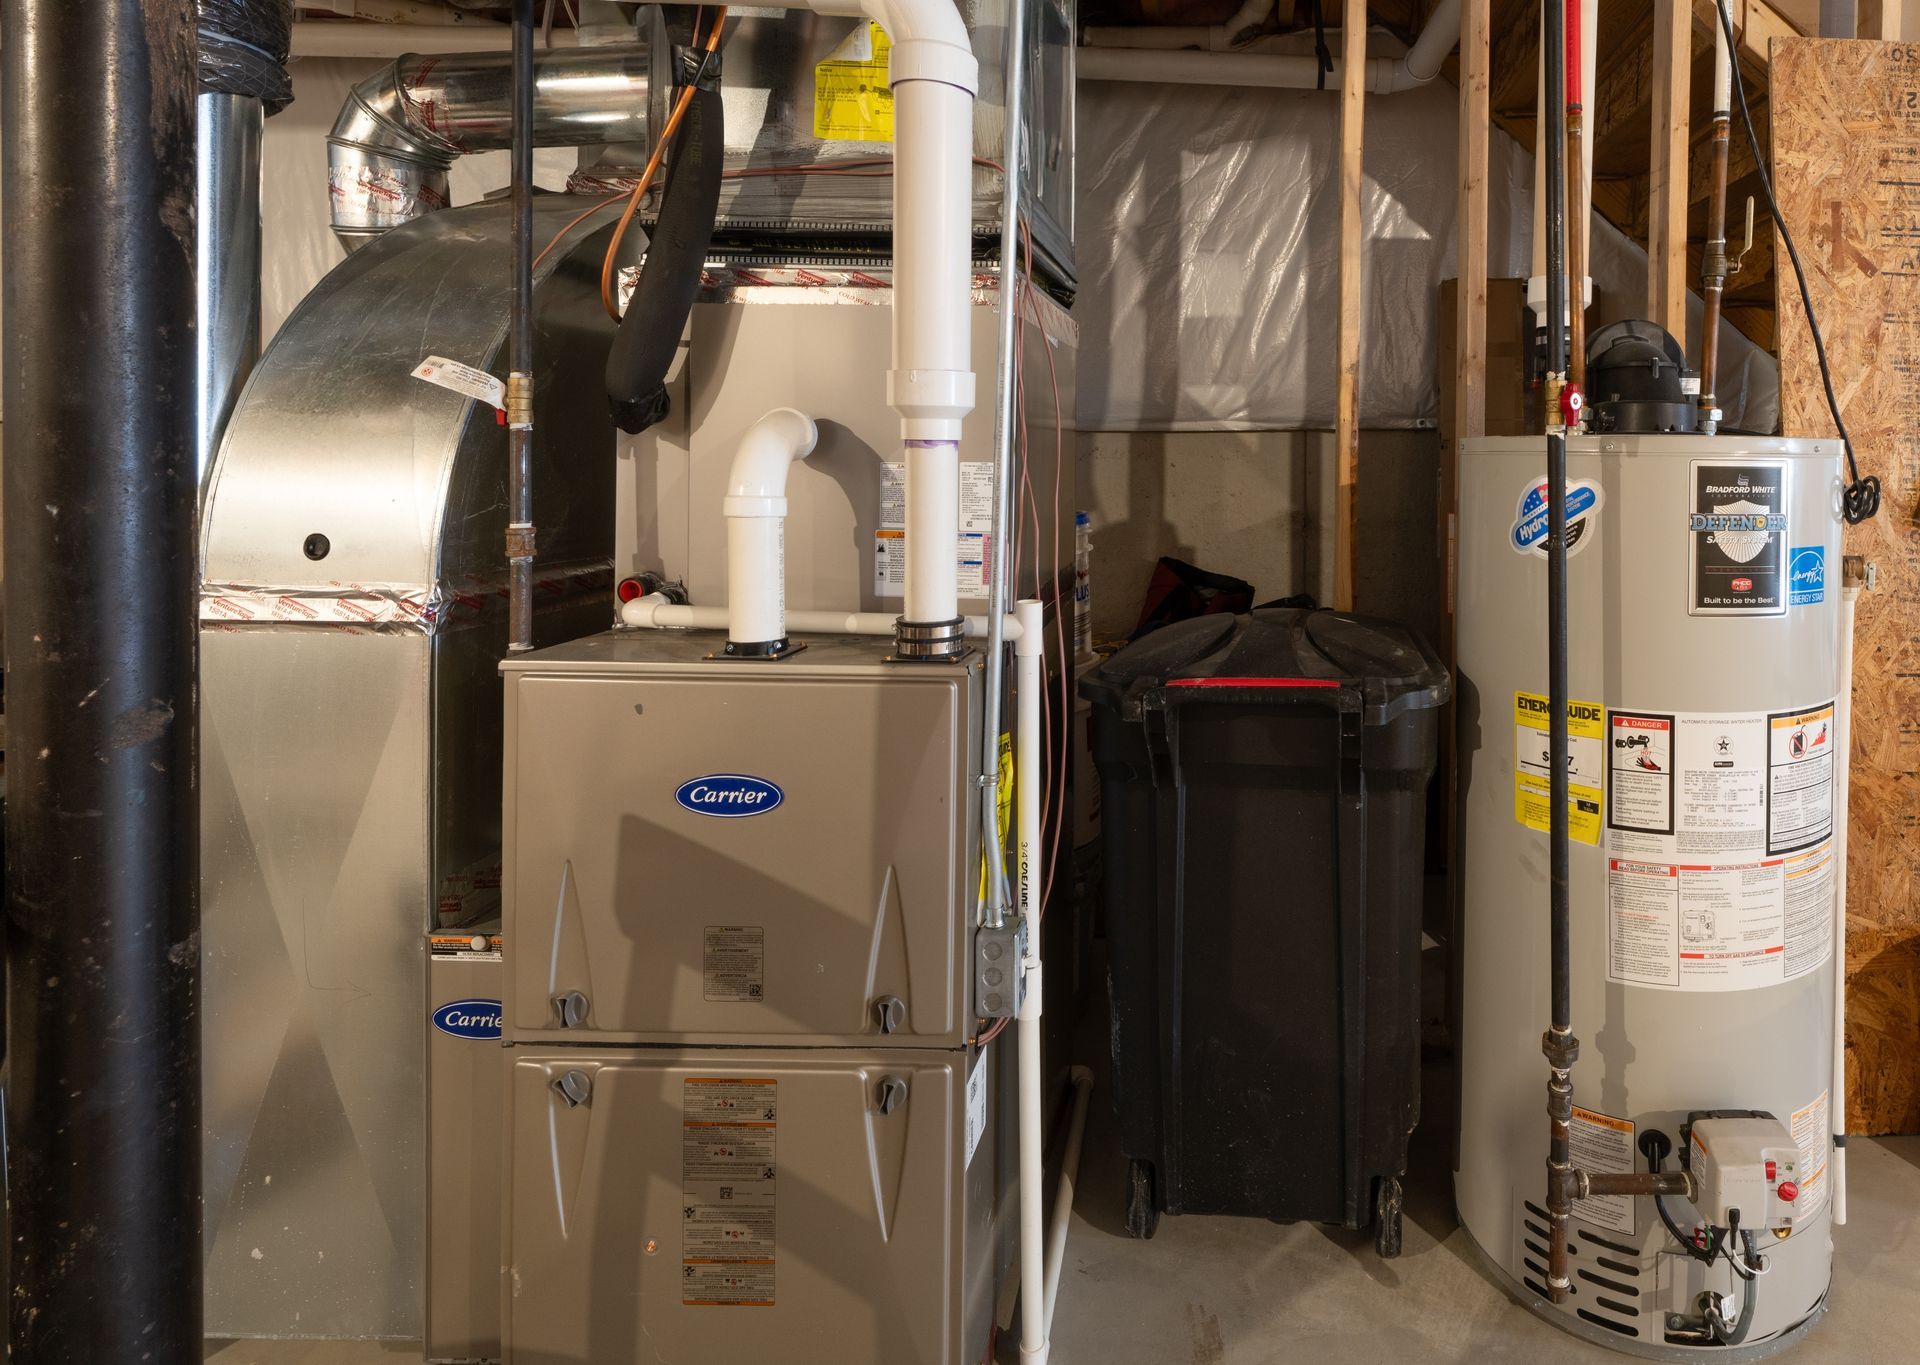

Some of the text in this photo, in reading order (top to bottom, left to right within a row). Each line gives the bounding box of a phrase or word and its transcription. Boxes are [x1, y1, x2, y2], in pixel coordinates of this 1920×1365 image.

[1705, 485, 1776, 494] BRADFORD WHITE
[1519, 514, 1549, 541] Hydro
[1690, 513, 1787, 532] DEFENDER
[1706, 536, 1774, 544] SAFETY SYSTEM
[1703, 596, 1722, 604] Built
[1790, 592, 1824, 604] ENERGY STAR
[212, 597, 254, 621] VentureTape
[277, 597, 318, 620] VentureTape
[689, 786, 768, 804] Carrier
[444, 1010, 502, 1028] Carrie
[1580, 1111, 1615, 1127] WARNING
